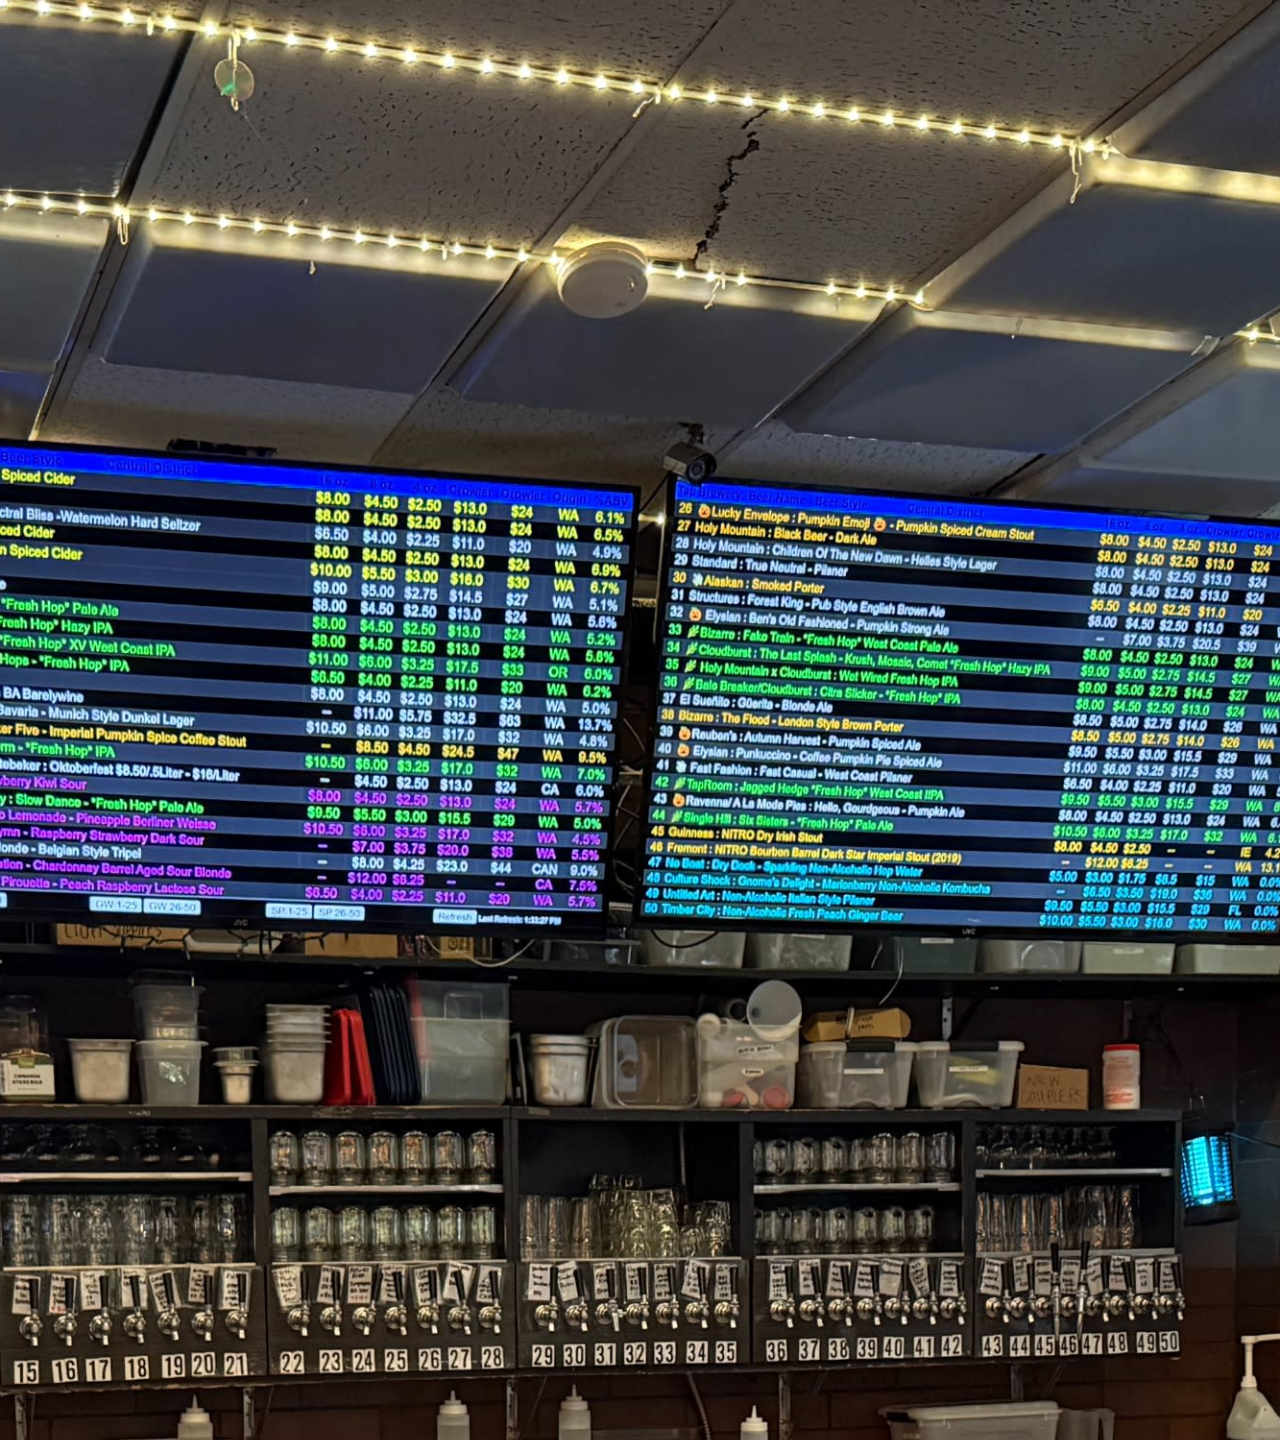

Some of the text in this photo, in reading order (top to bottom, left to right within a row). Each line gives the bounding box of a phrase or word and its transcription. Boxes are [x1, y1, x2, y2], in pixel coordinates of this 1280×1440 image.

[0, 469, 41, 485] Spiced
[43, 471, 75, 486] Cider
[316, 490, 350, 506] $8.00
[364, 494, 398, 509] $4.50
[408, 498, 441, 512] $2.50
[453, 501, 487, 515] $13.0
[511, 505, 533, 519] $24
[559, 508, 579, 522] WA
[282, 1353, 303, 1372] 22
[322, 1352, 341, 1371] 23
[354, 1351, 373, 1371] 24
[386, 1350, 406, 1370] 25
